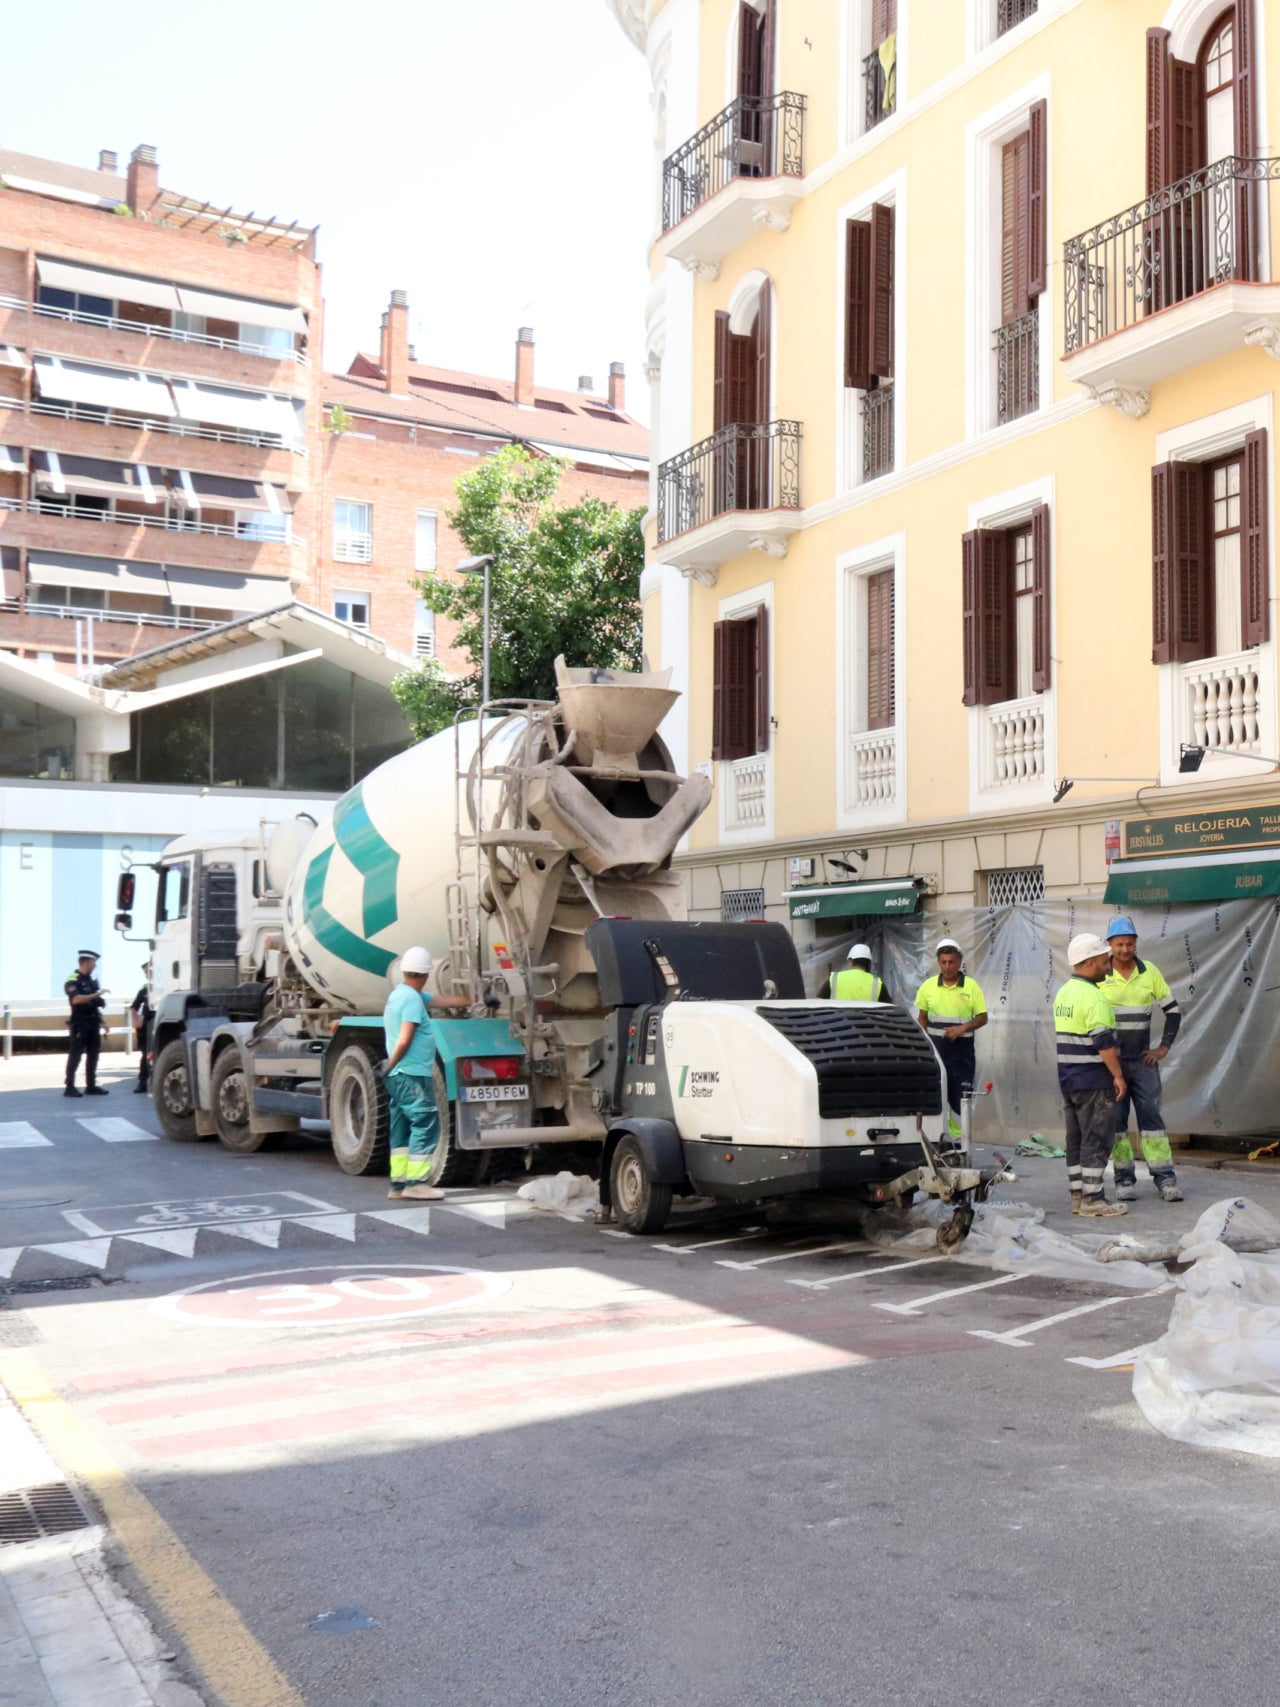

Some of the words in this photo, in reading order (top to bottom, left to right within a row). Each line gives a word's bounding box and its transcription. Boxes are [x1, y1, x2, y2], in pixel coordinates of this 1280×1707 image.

[1174, 816, 1252, 834] RELOJERIA
[1199, 833, 1225, 844] JOYERIA
[20, 842, 34, 870] E
[119, 844, 133, 872] S
[1234, 874, 1263, 889] JUBAR
[690, 1071, 721, 1084] SCHWING
[470, 1087, 500, 1099] 4850
[635, 1081, 644, 1096] TP
[691, 1085, 714, 1098] Stetter
[225, 1273, 433, 1316] 30
